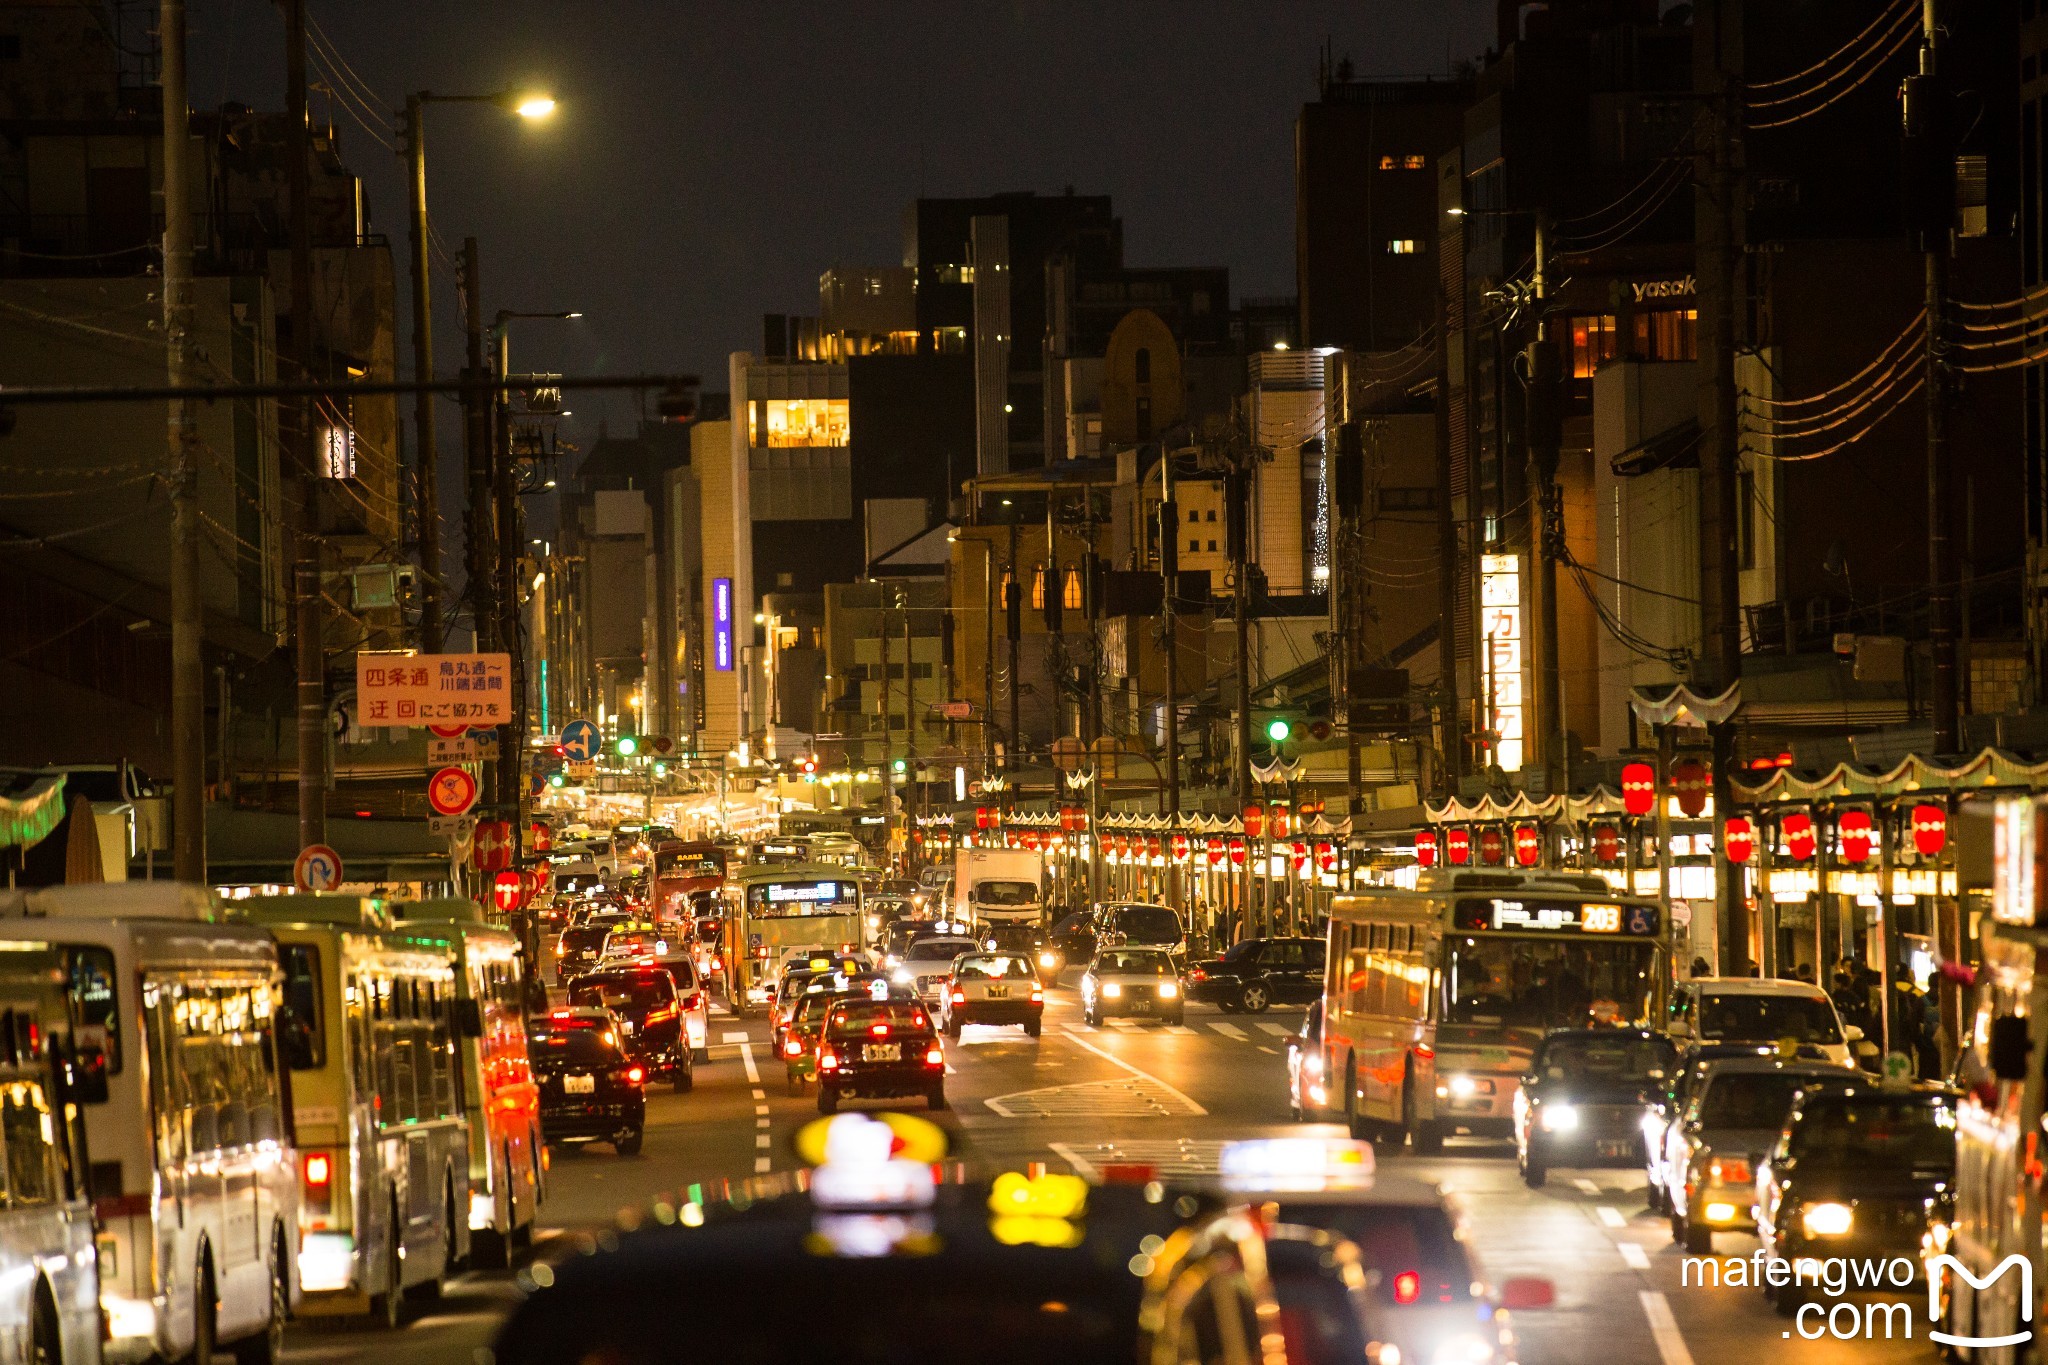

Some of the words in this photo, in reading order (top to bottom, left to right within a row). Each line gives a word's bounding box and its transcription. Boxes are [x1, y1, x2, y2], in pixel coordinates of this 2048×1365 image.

[366, 668, 429, 687] 四条通
[1490, 609, 1516, 734] カラオケ
[439, 676, 503, 691] 川端通間
[1583, 905, 1619, 930] 203
